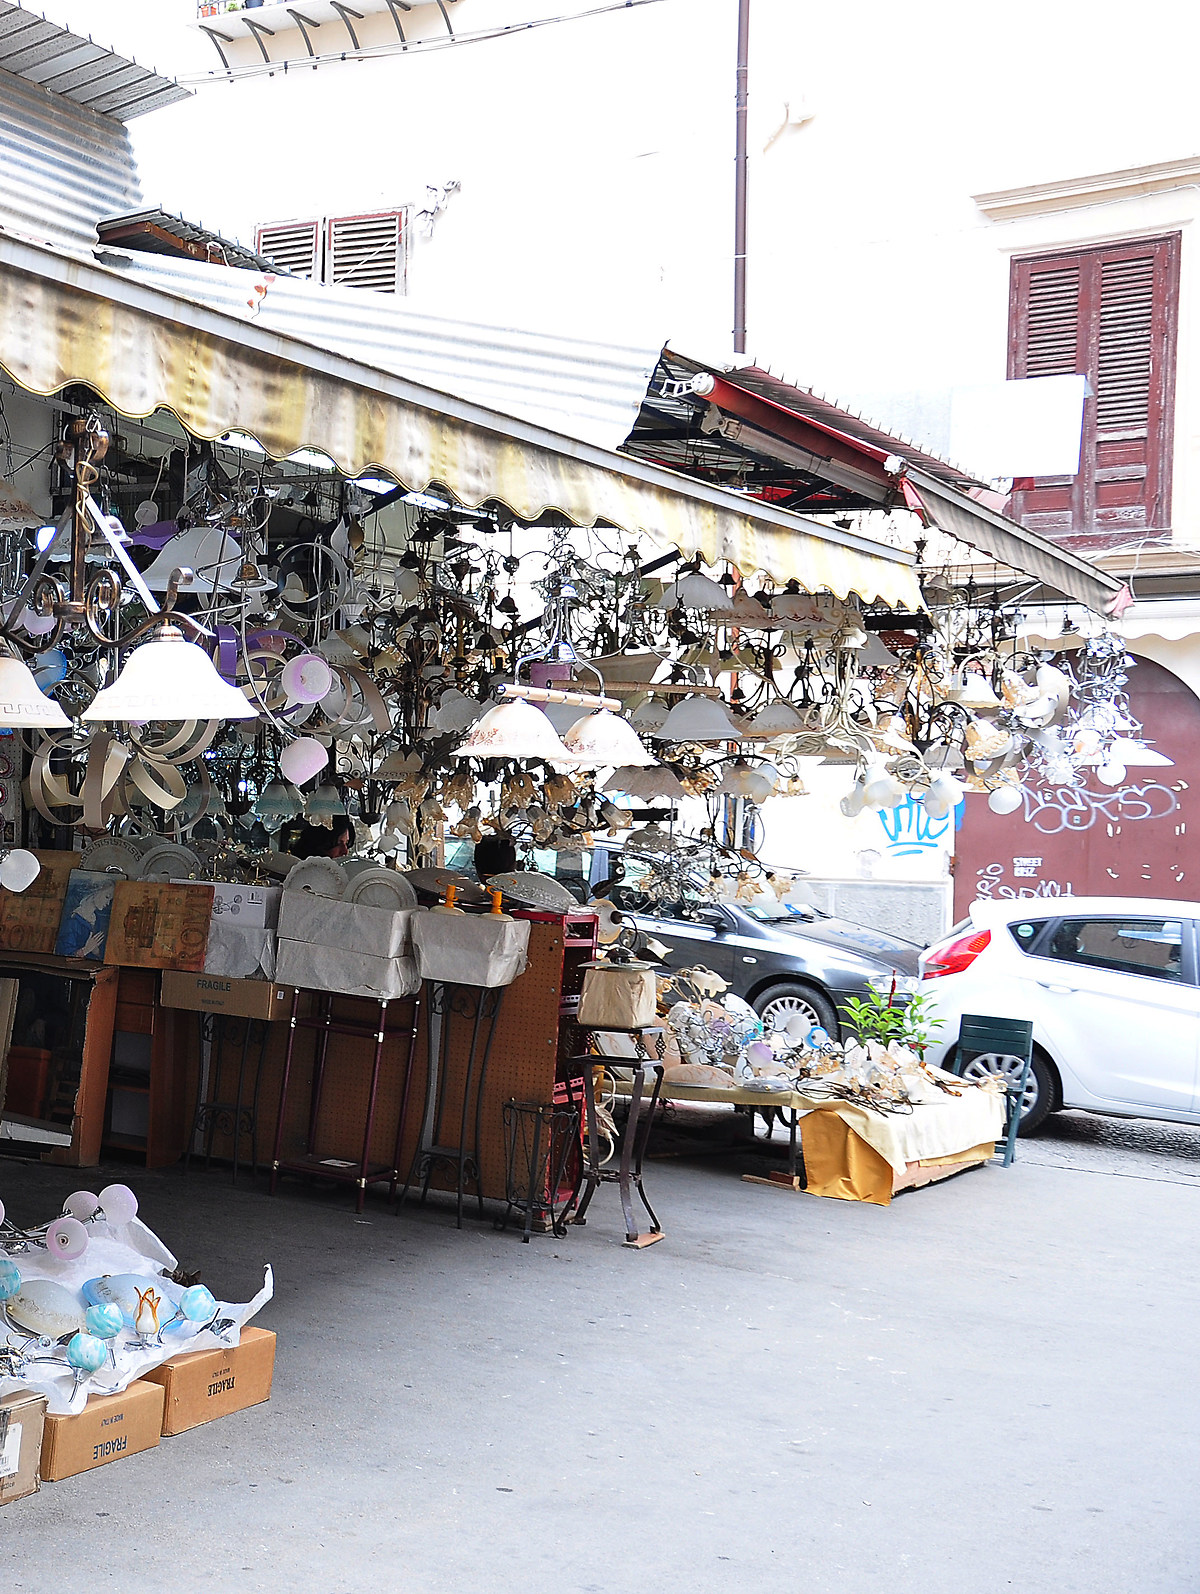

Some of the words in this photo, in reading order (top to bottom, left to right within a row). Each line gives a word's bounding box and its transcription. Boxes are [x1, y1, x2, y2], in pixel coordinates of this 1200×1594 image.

[196, 979, 232, 992] FRAGILE
[207, 1376, 235, 1397] FRAGILE
[113, 1413, 124, 1423] MADE
[92, 1435, 128, 1460] FRAGILE
